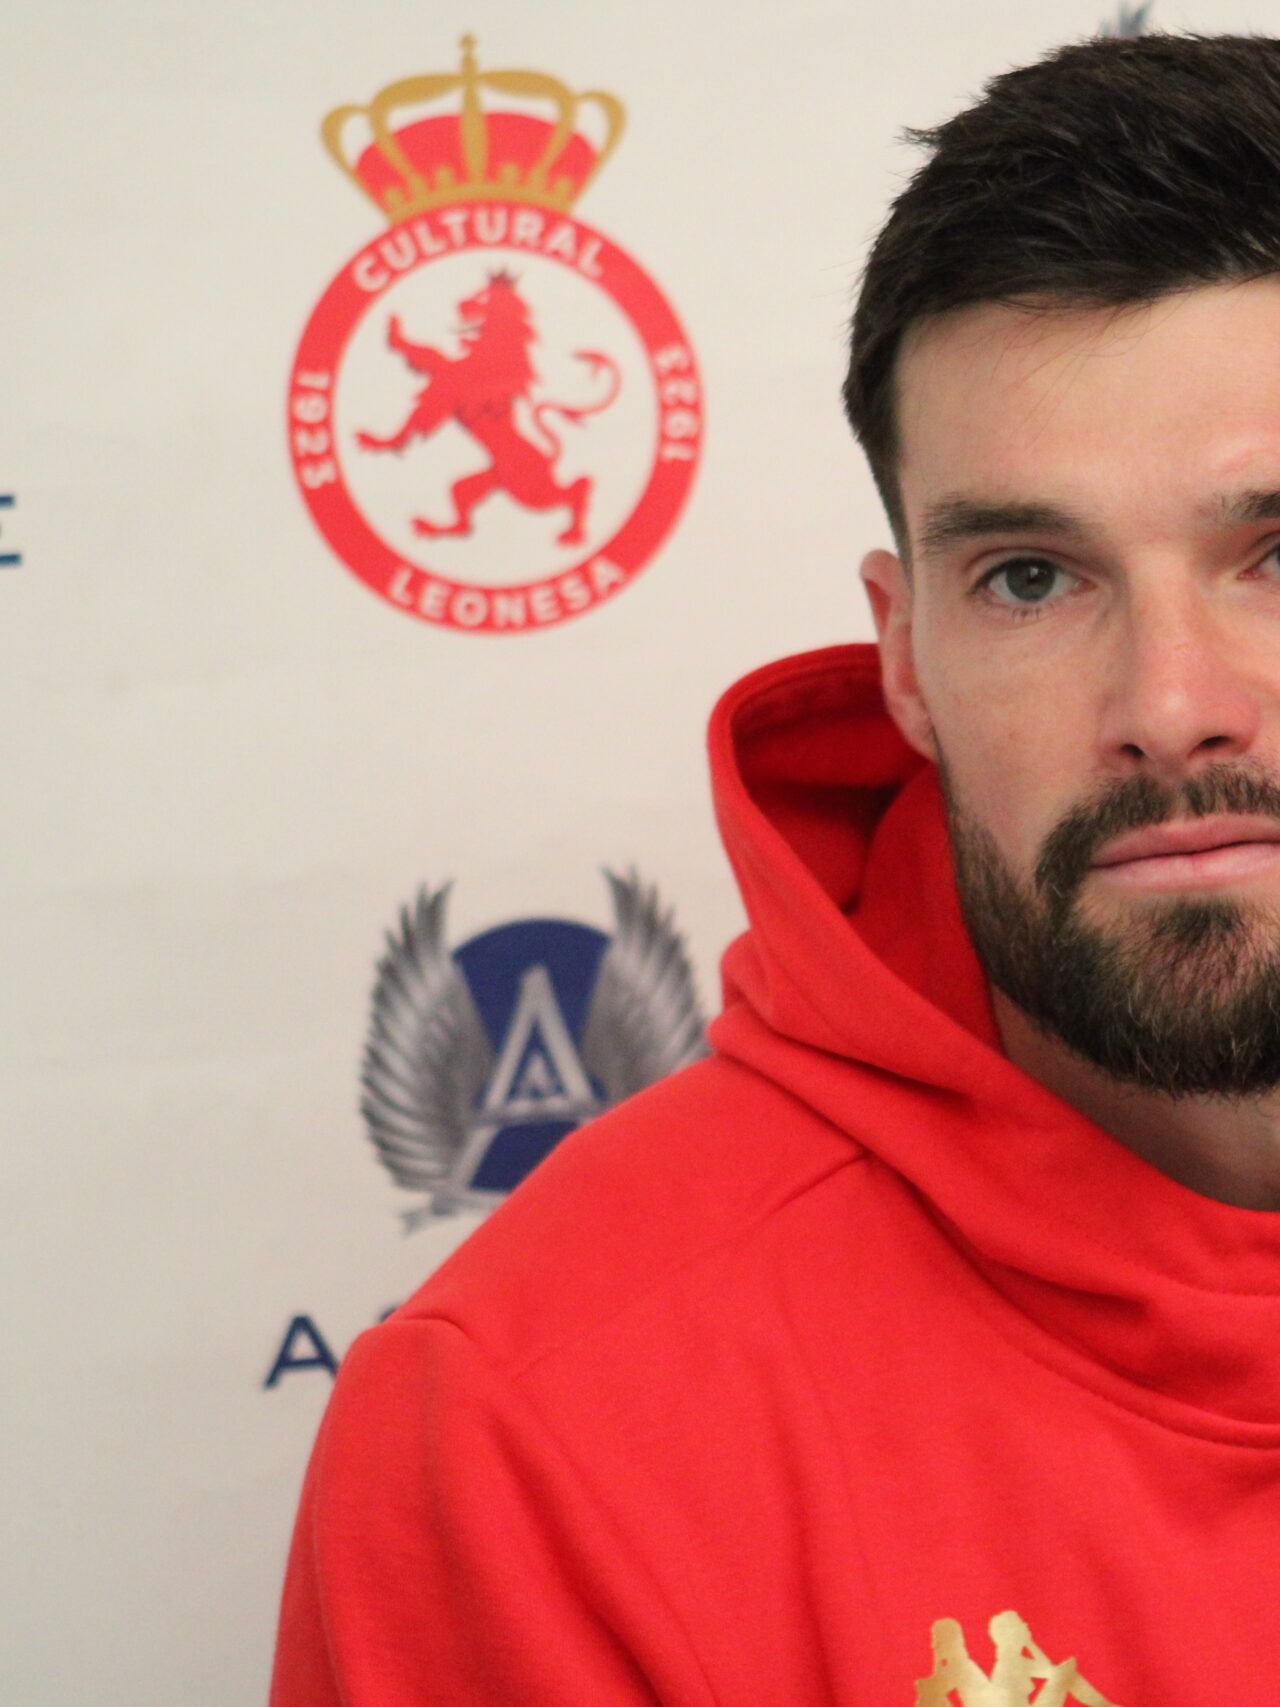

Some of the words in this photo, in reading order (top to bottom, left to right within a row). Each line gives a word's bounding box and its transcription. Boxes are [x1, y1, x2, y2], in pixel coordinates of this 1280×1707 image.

[352, 207, 605, 293] CULTURAL
[293, 369, 339, 491] 1923
[653, 342, 703, 462] 1923
[387, 555, 628, 630] LEONESA
